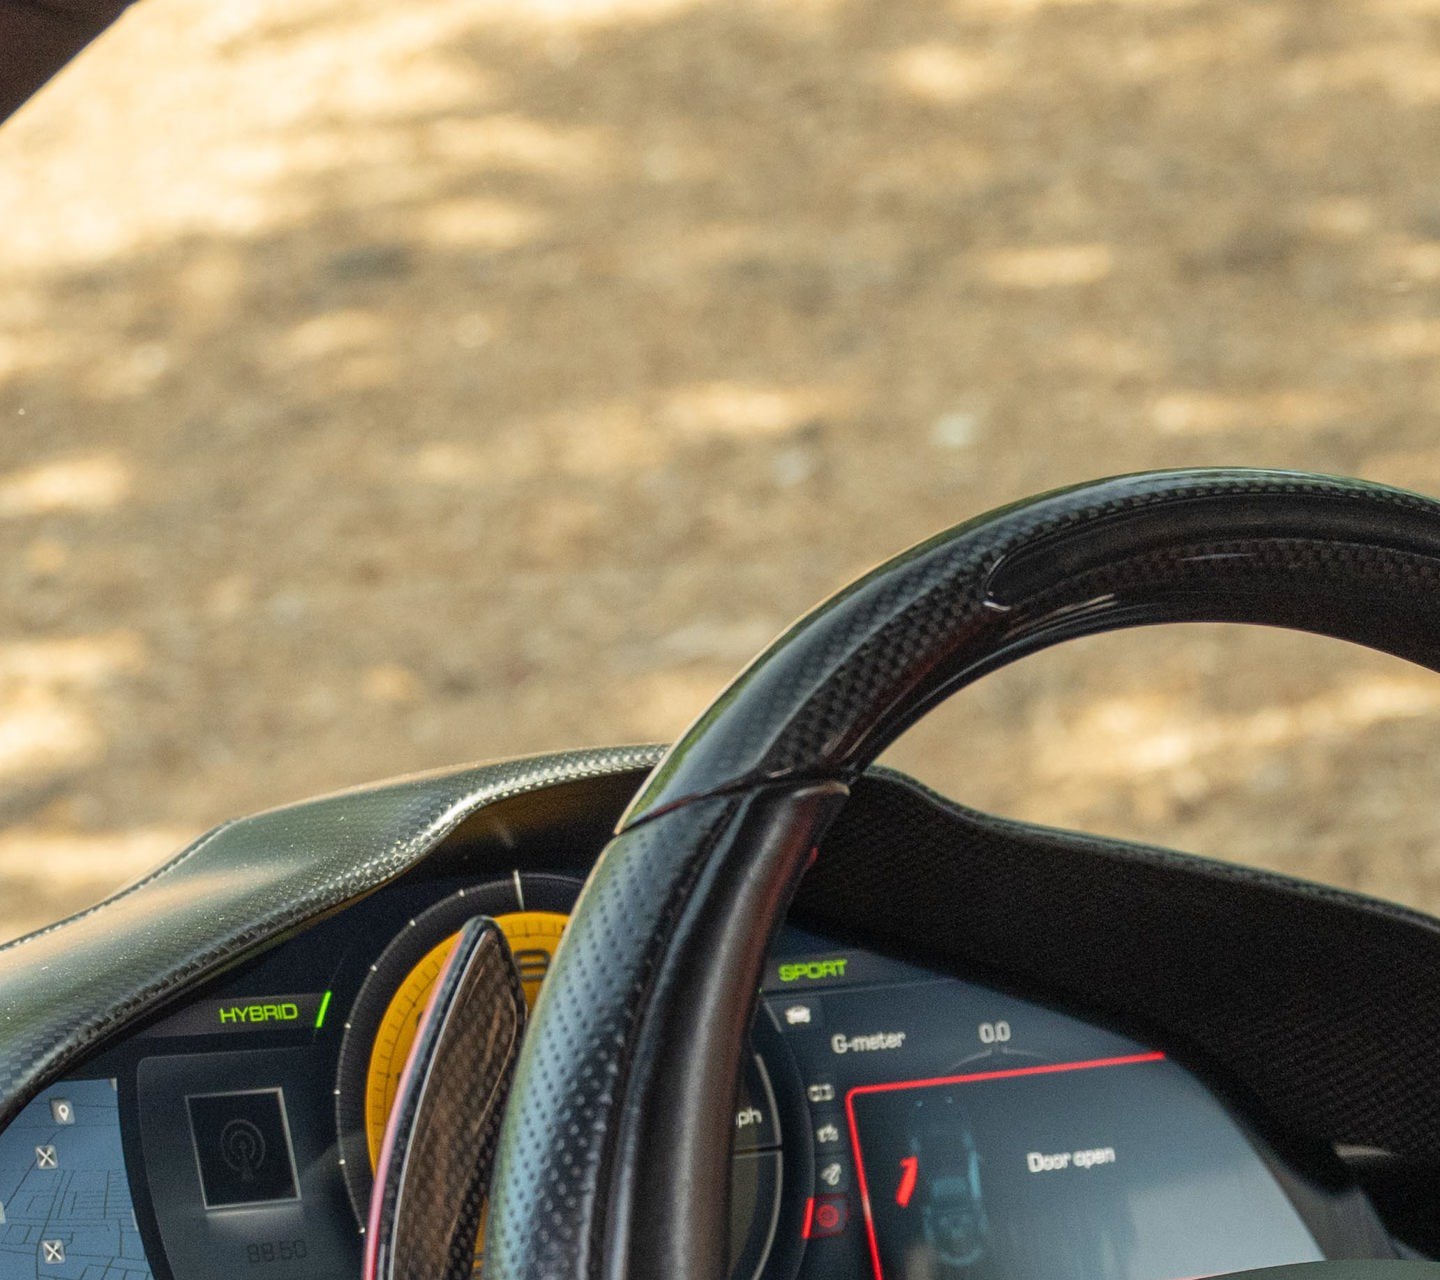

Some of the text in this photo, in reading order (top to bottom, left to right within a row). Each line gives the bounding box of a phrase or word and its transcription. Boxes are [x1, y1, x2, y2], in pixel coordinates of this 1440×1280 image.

[778, 958, 848, 982] SPORT
[220, 1003, 298, 1023] HYBRID
[831, 1032, 906, 1054] G-meter
[1026, 1147, 1116, 1173] Door open
